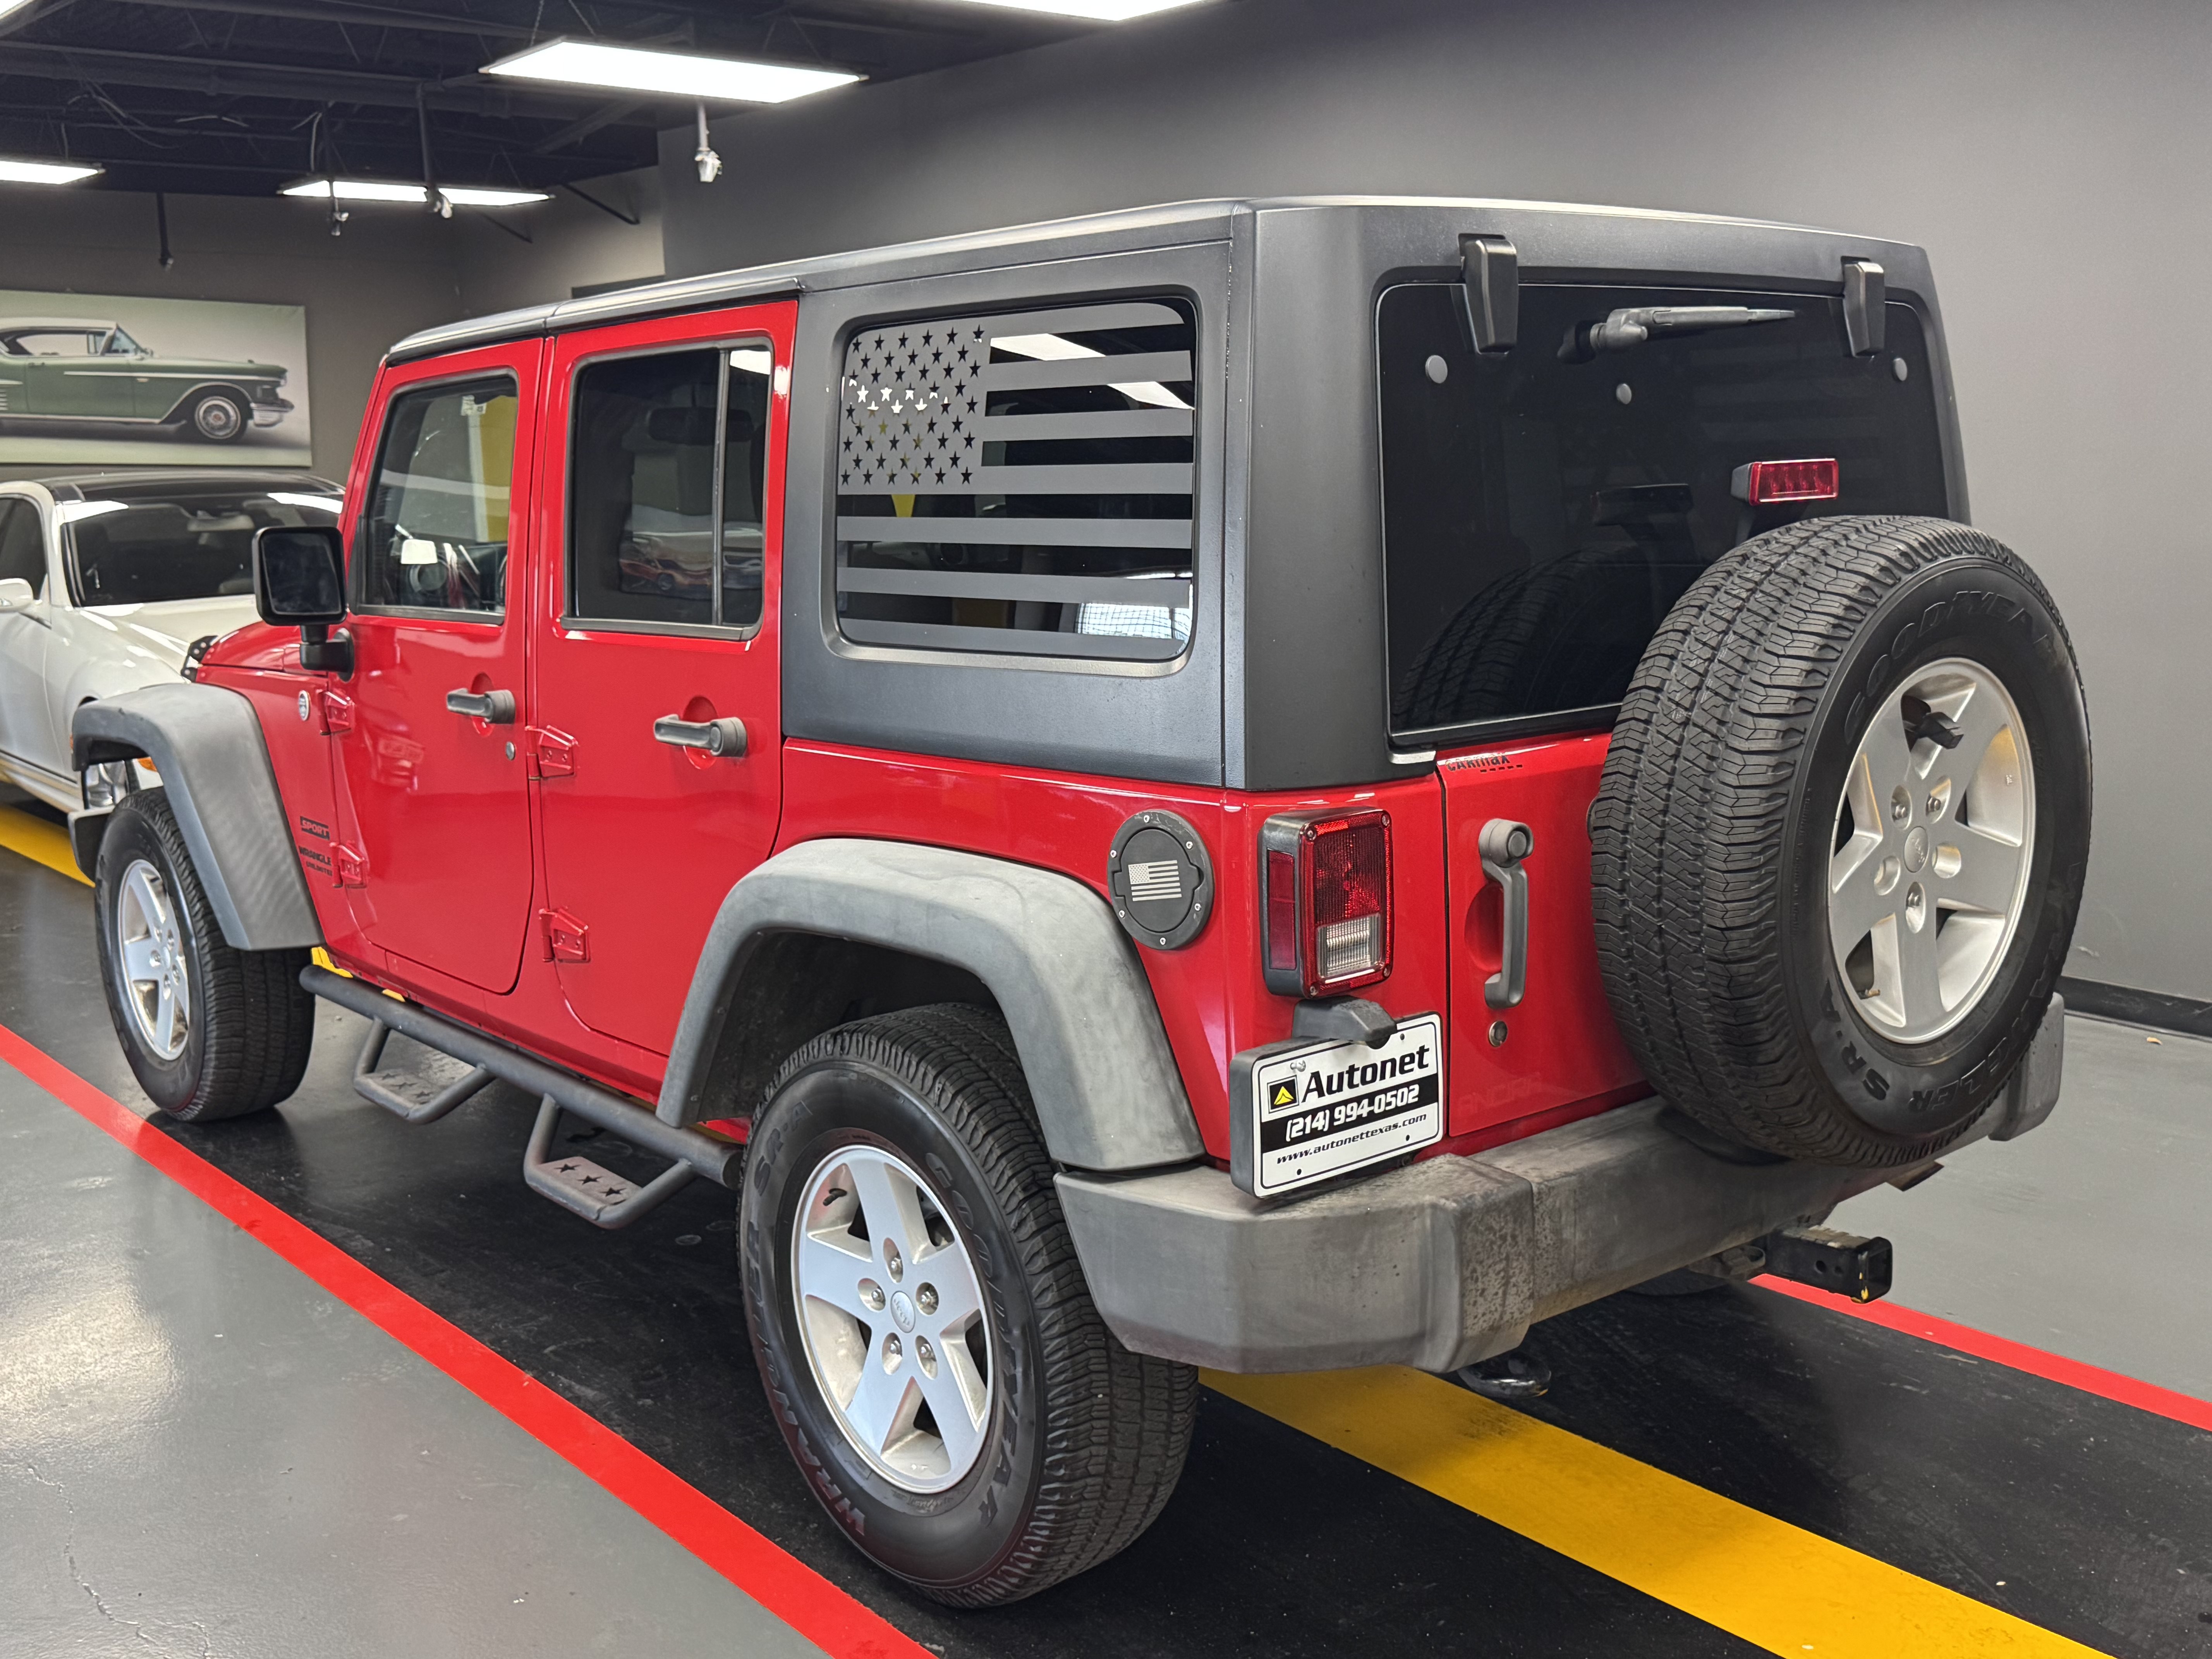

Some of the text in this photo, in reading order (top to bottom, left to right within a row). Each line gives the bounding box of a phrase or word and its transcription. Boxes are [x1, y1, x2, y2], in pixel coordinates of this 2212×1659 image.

[302, 820, 328, 836] SPORT
[299, 845, 332, 866] WRANGLE
[1301, 1044, 1430, 1103] Autonet
[1285, 1084, 1420, 1142] (214) 994-0502
[1276, 1114, 1427, 1164] www.autonettexas.com
